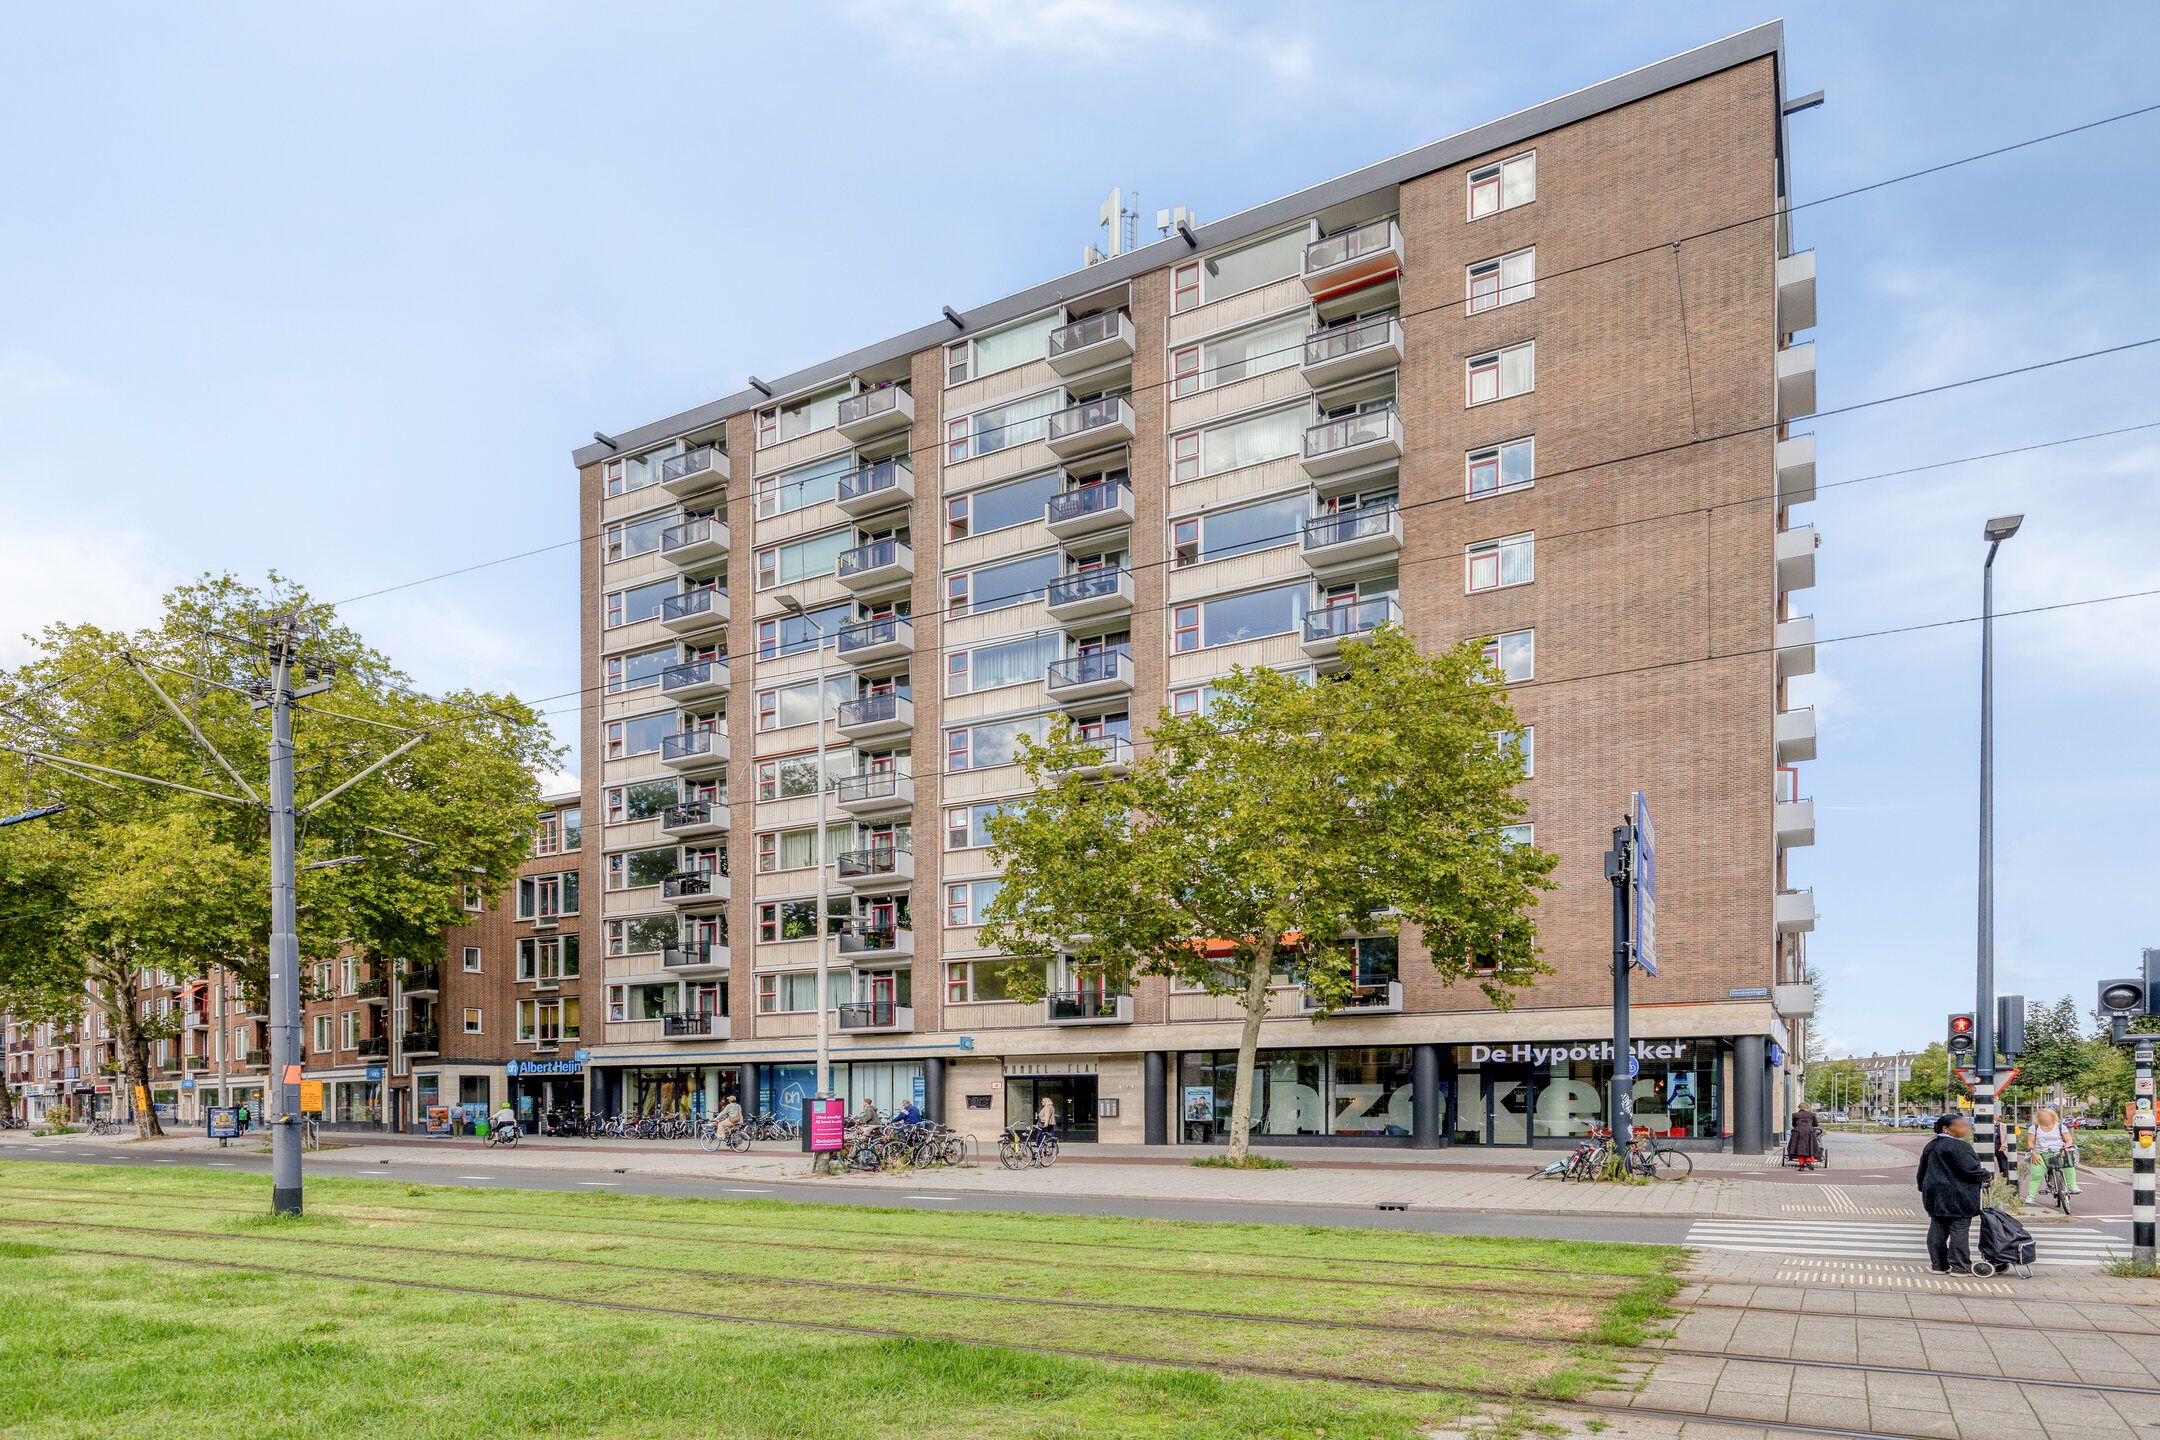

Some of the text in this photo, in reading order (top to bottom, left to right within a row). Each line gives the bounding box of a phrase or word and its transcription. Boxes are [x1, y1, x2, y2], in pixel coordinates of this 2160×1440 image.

[1471, 1045, 1507, 1062] De
[519, 1060, 581, 1075] Albert Heijn
[1067, 1063, 1098, 1073] FLAT
